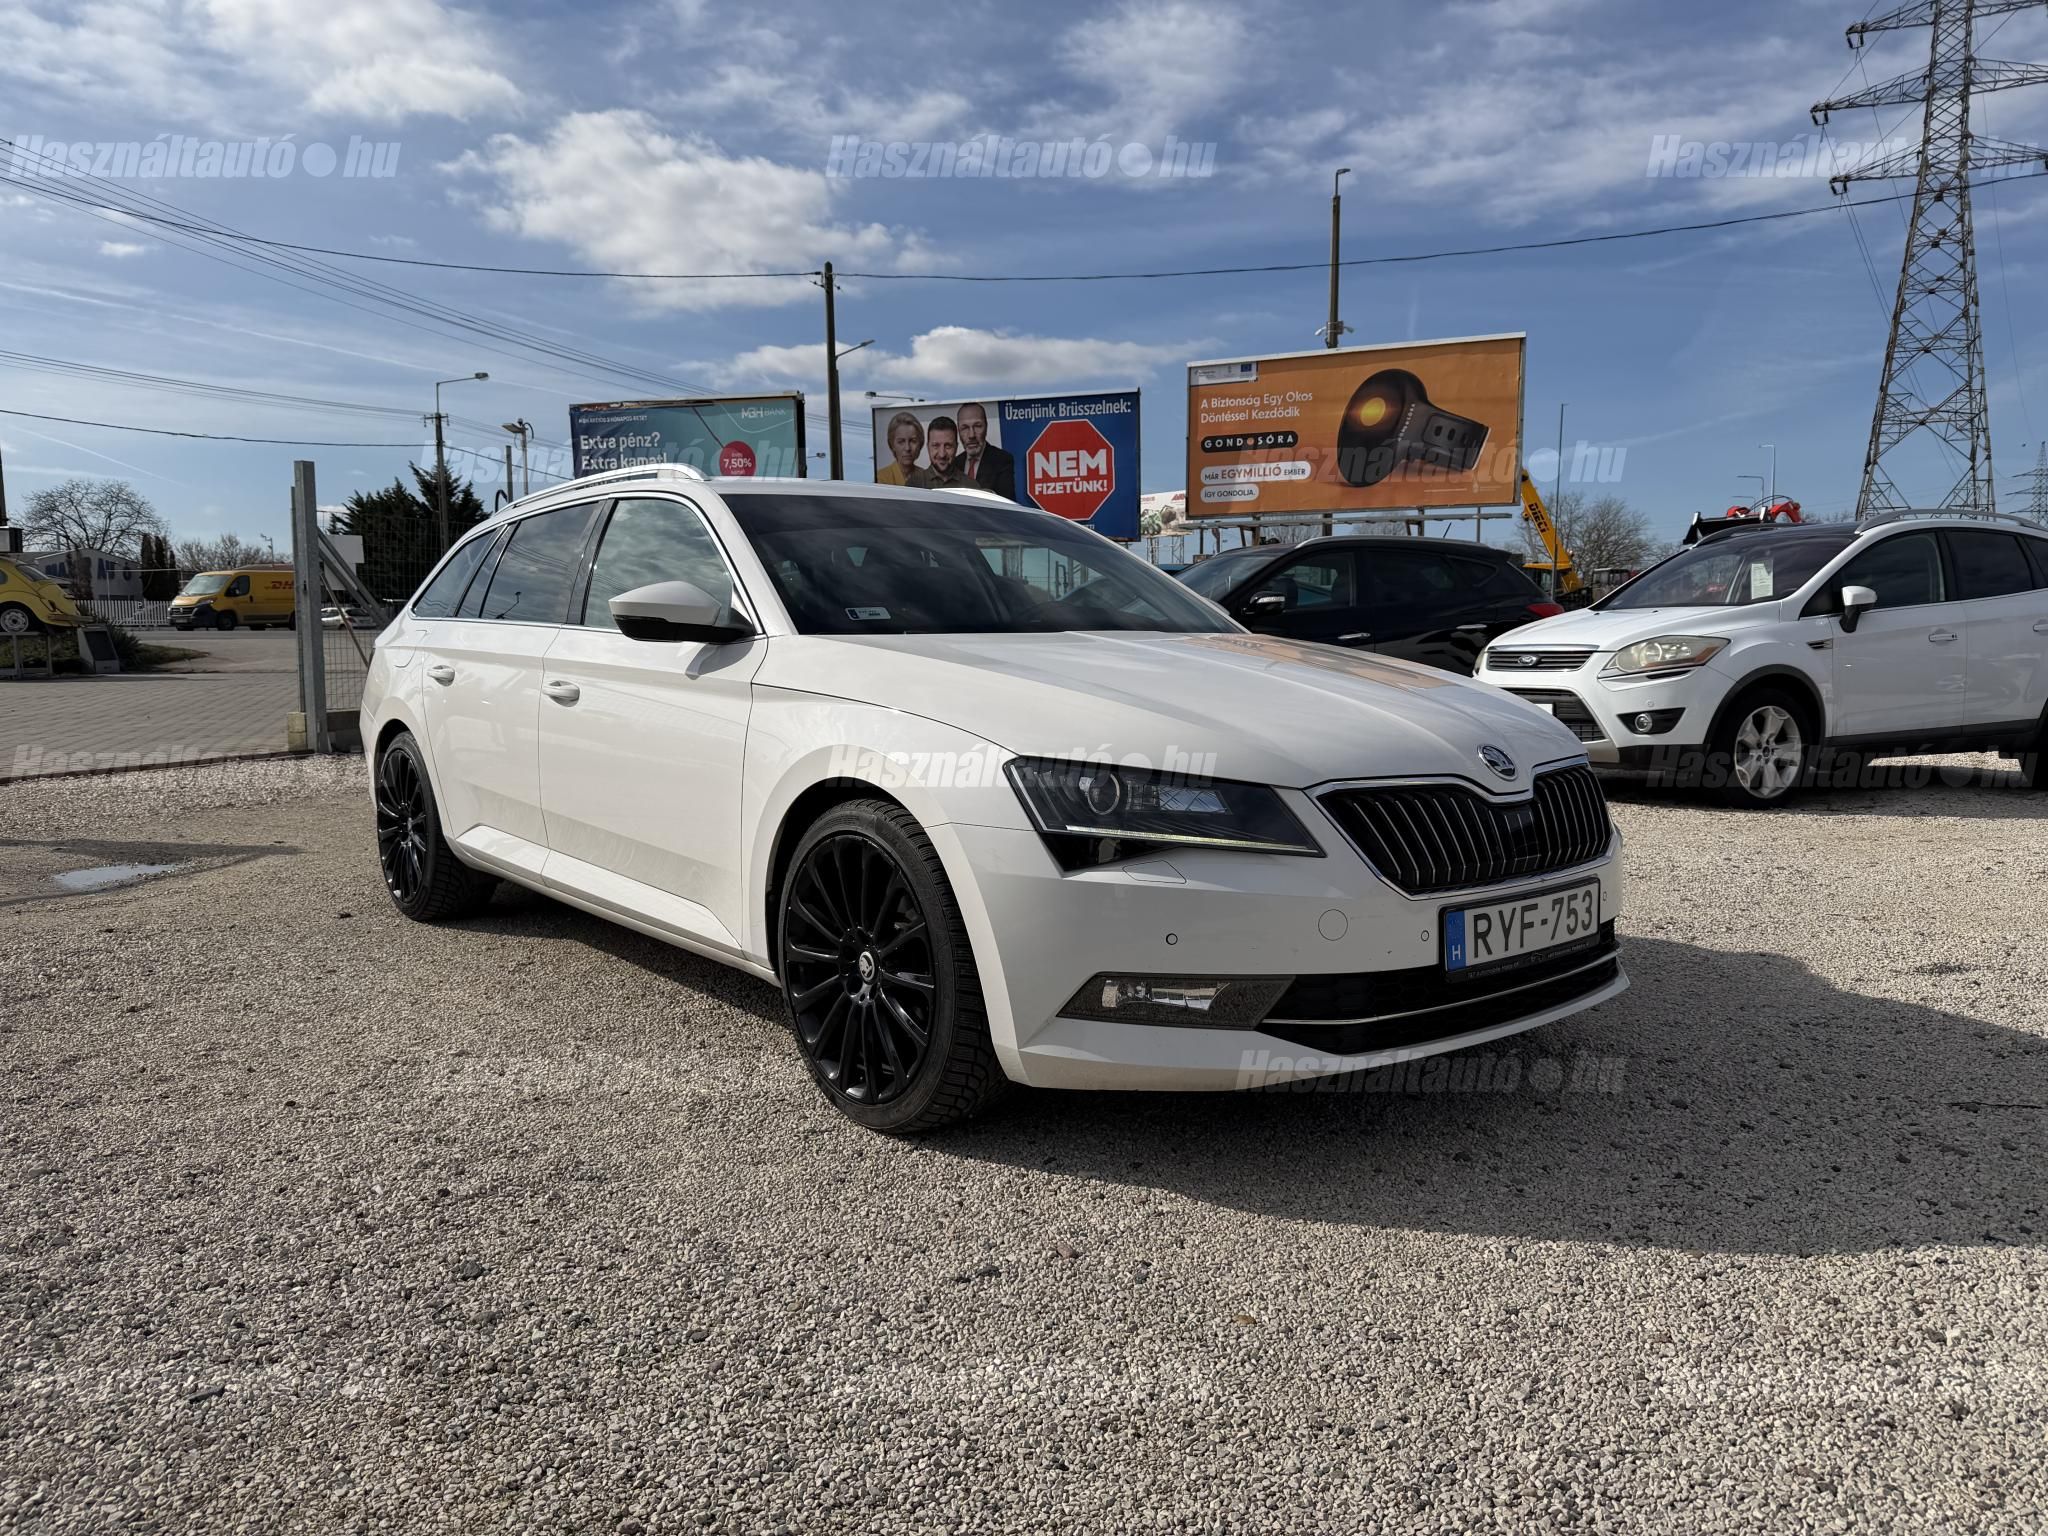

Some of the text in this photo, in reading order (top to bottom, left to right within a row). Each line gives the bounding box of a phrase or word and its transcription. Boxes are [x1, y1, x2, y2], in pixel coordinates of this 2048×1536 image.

[1200, 391, 1313, 409] A Biztonság Egy Okos
[1005, 398, 1132, 422] Üzenjünk Brüsszelnek:
[1200, 410, 1249, 424] Döntéssel
[580, 431, 660, 452] Extra pénz?
[581, 455, 618, 470] Extra
[723, 457, 752, 469] 7,50%
[1034, 448, 1107, 479] NEM
[1204, 463, 1306, 481] MÁR EGYMILLIÓ EMBER
[1034, 477, 1108, 495] FIZETÜNK!
[1473, 889, 1593, 958] RYF-753
[1451, 944, 1461, 960] H
